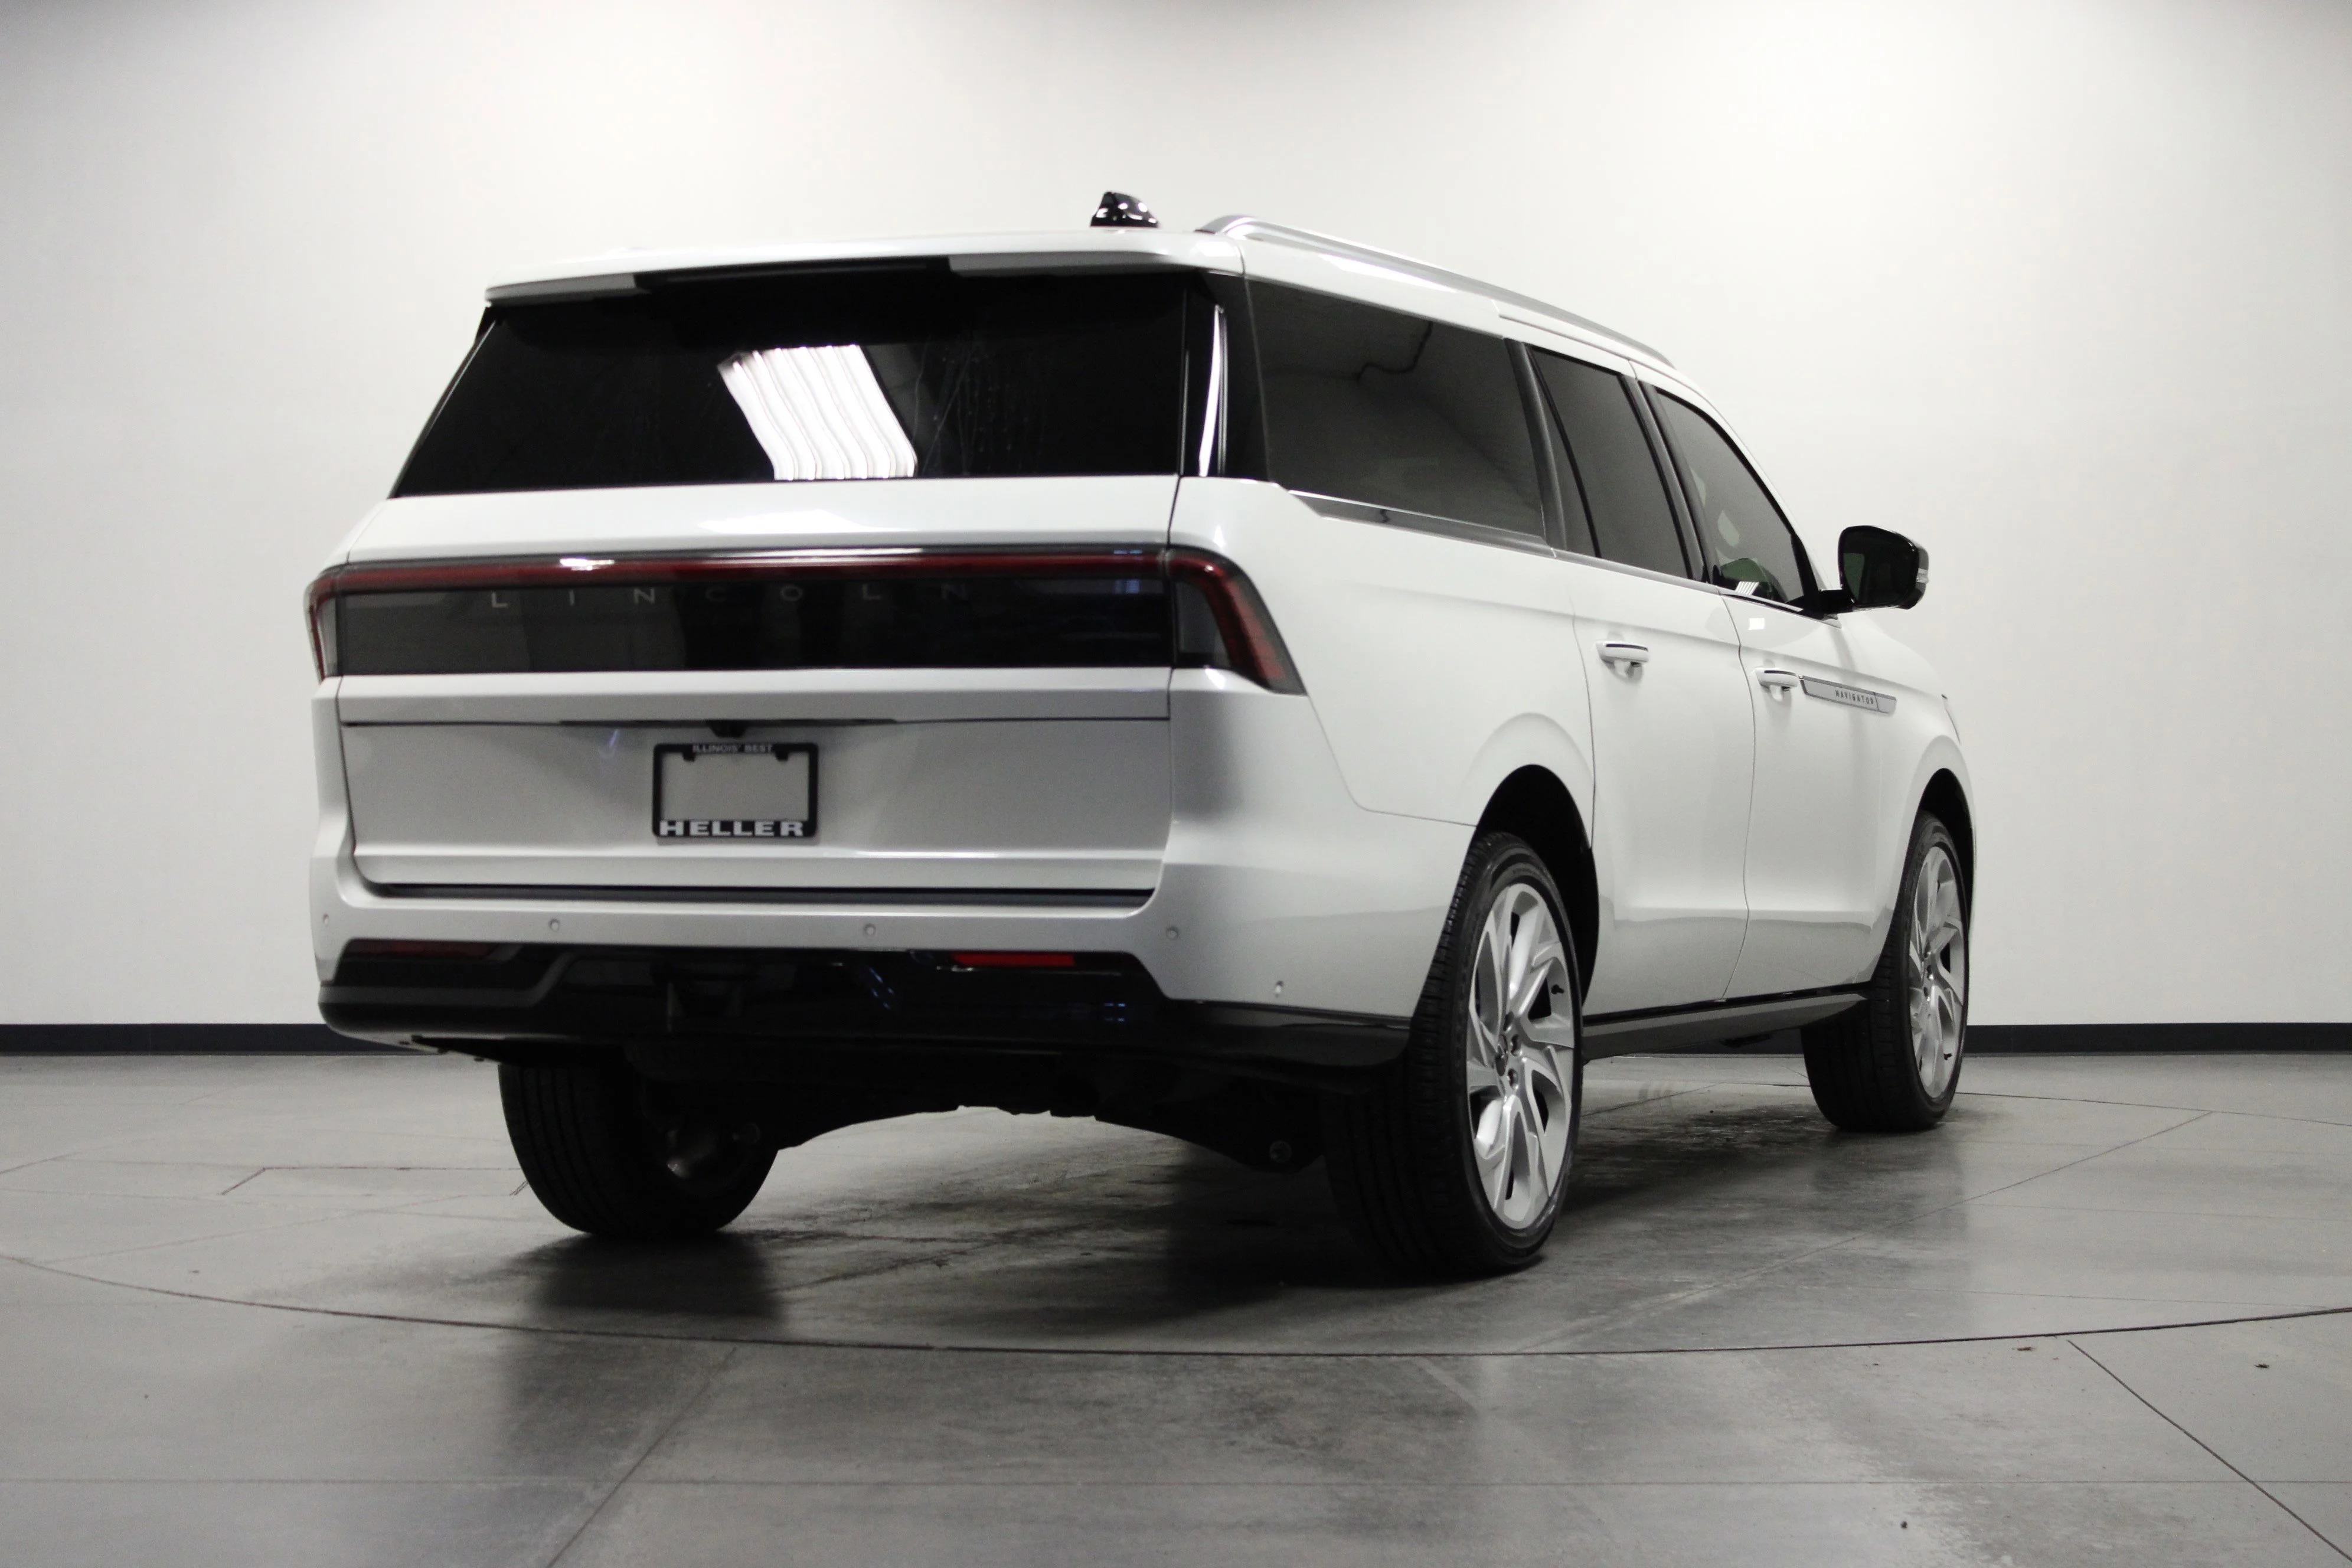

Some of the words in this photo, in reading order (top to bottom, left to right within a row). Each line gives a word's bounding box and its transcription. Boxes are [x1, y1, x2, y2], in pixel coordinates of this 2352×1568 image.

[491, 582, 968, 609] LINCOLN
[1835, 690, 1874, 704] NAVIGATOR
[659, 820, 804, 837] HELLER
